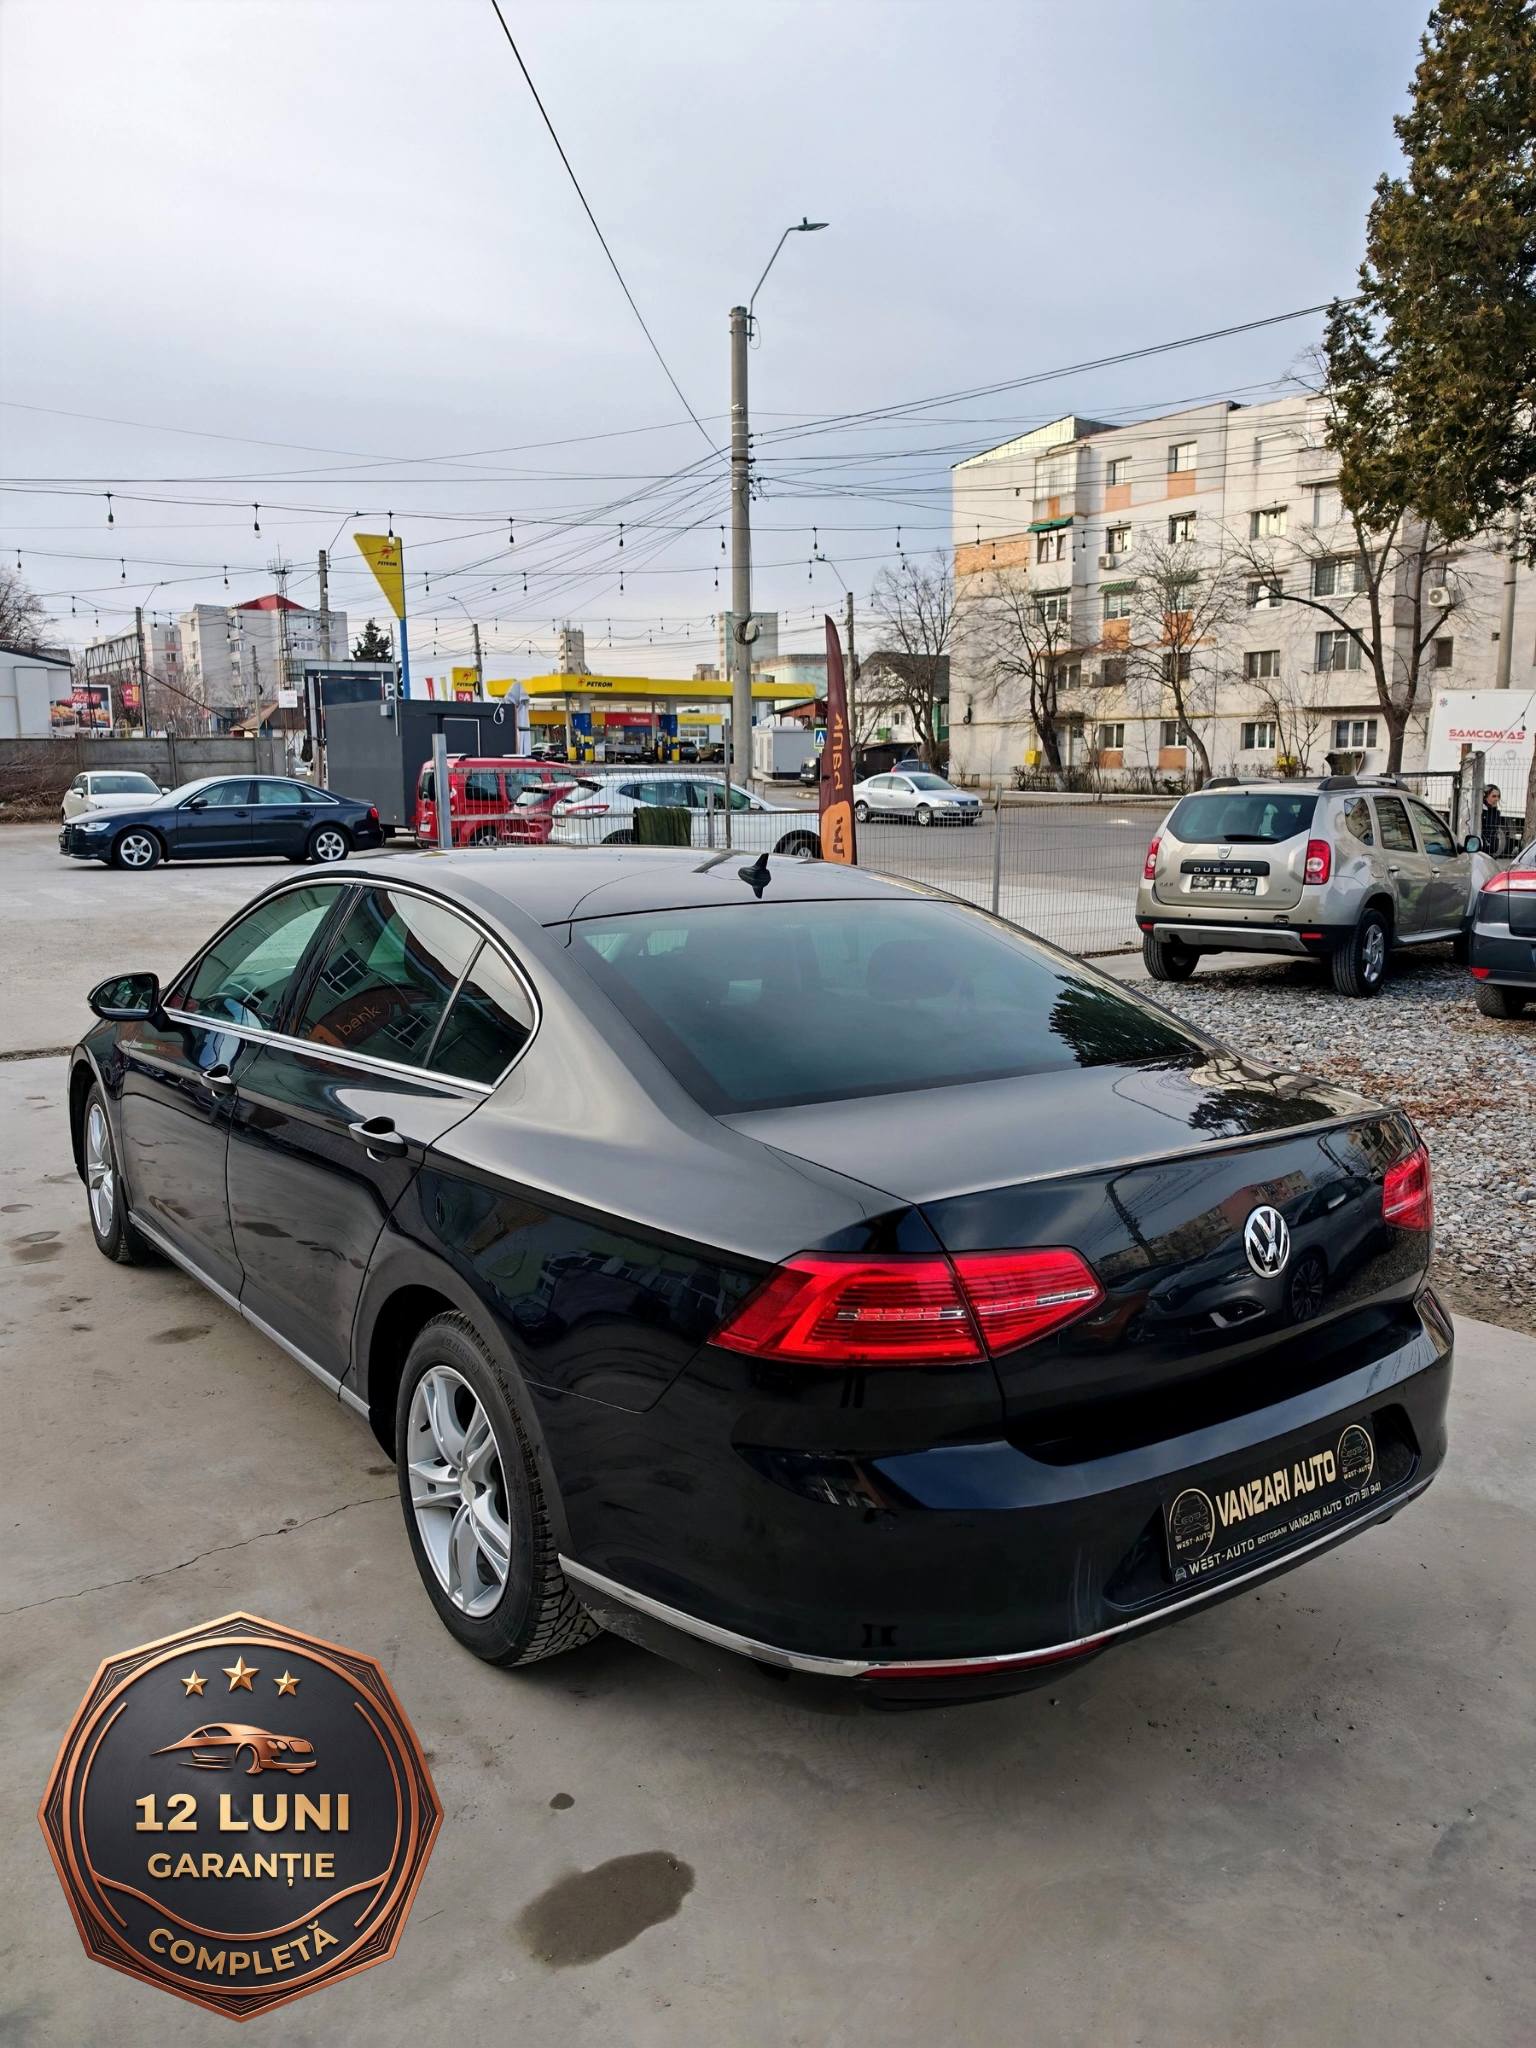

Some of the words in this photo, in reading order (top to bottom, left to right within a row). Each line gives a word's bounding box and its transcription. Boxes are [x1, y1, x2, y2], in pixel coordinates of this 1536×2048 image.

[1448, 728, 1504, 739] SAMCOM
[1506, 731, 1526, 741] AS
[336, 1004, 384, 1036] bank
[1215, 1467, 1290, 1528] VANZARI
[1293, 1449, 1337, 1498] AUTO
[1176, 1531, 1212, 1550] WEST-AUTO
[1188, 1538, 1255, 1576] WEST-AUTO
[1289, 1510, 1321, 1532] VANZARI
[1322, 1500, 1343, 1518] AUTO
